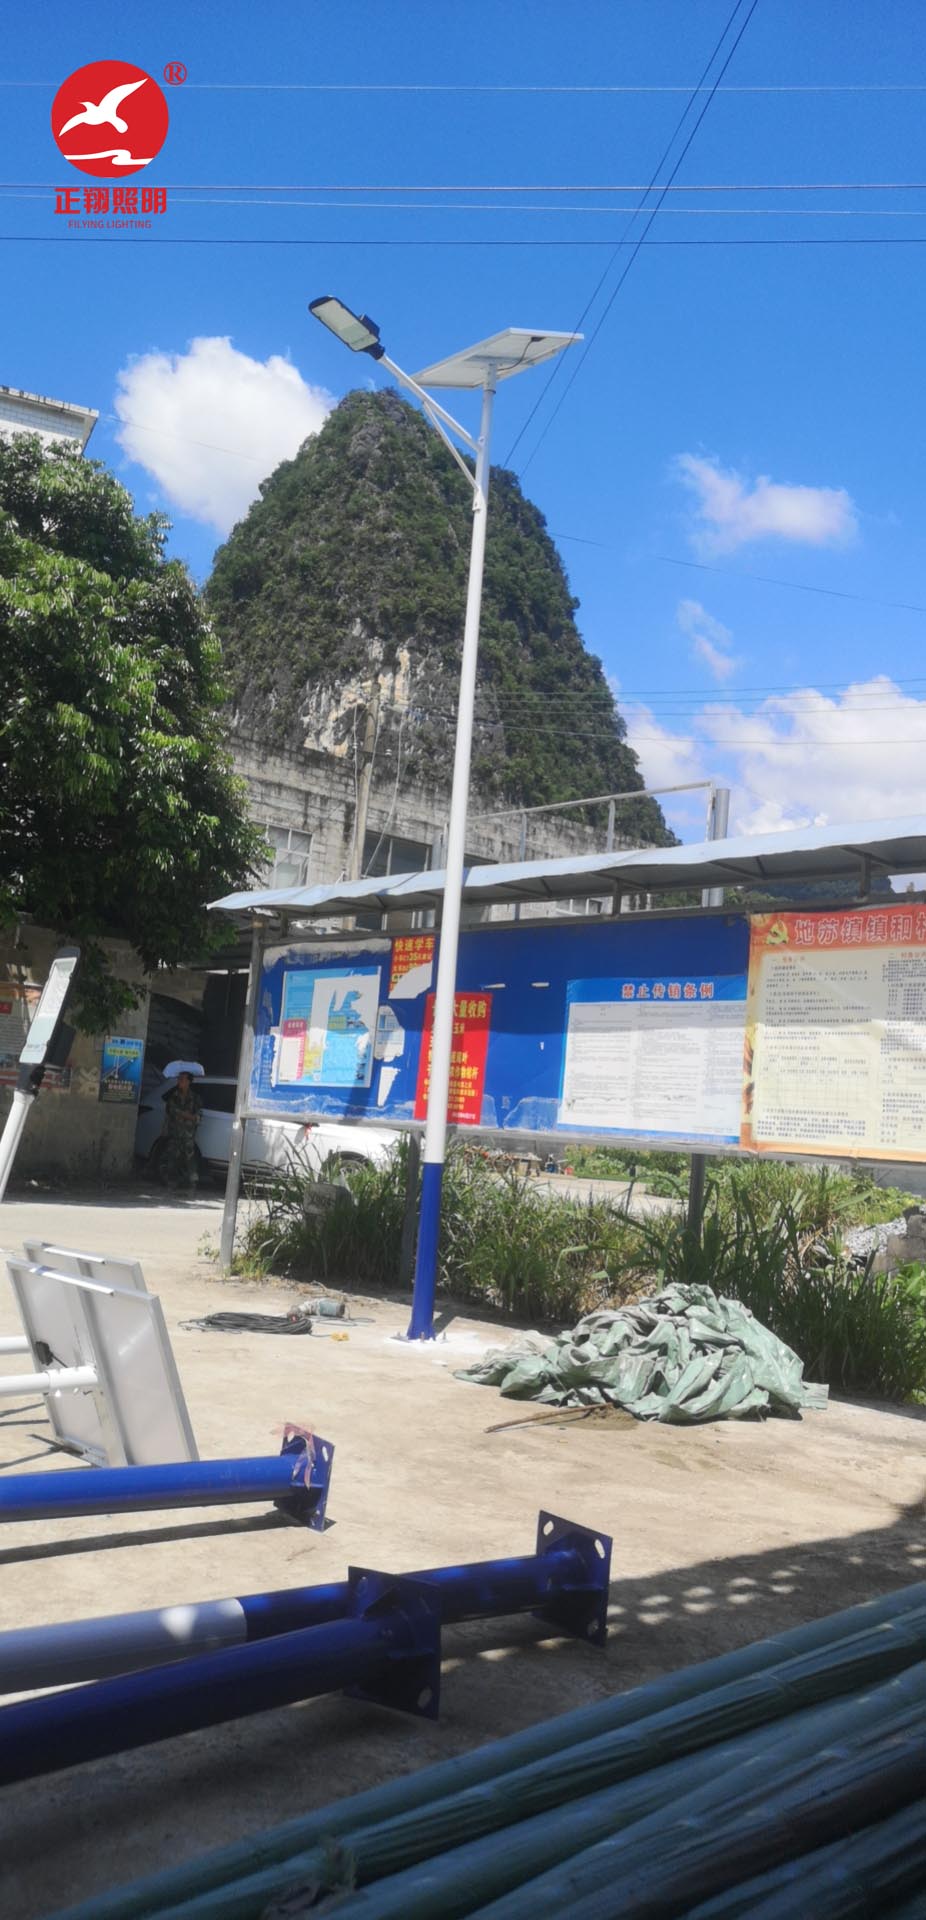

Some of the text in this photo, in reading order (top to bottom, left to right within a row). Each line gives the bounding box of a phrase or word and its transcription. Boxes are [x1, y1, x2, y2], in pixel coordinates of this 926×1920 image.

[394, 936, 434, 953] 快速学车
[621, 982, 714, 1000] 禁止传销条例
